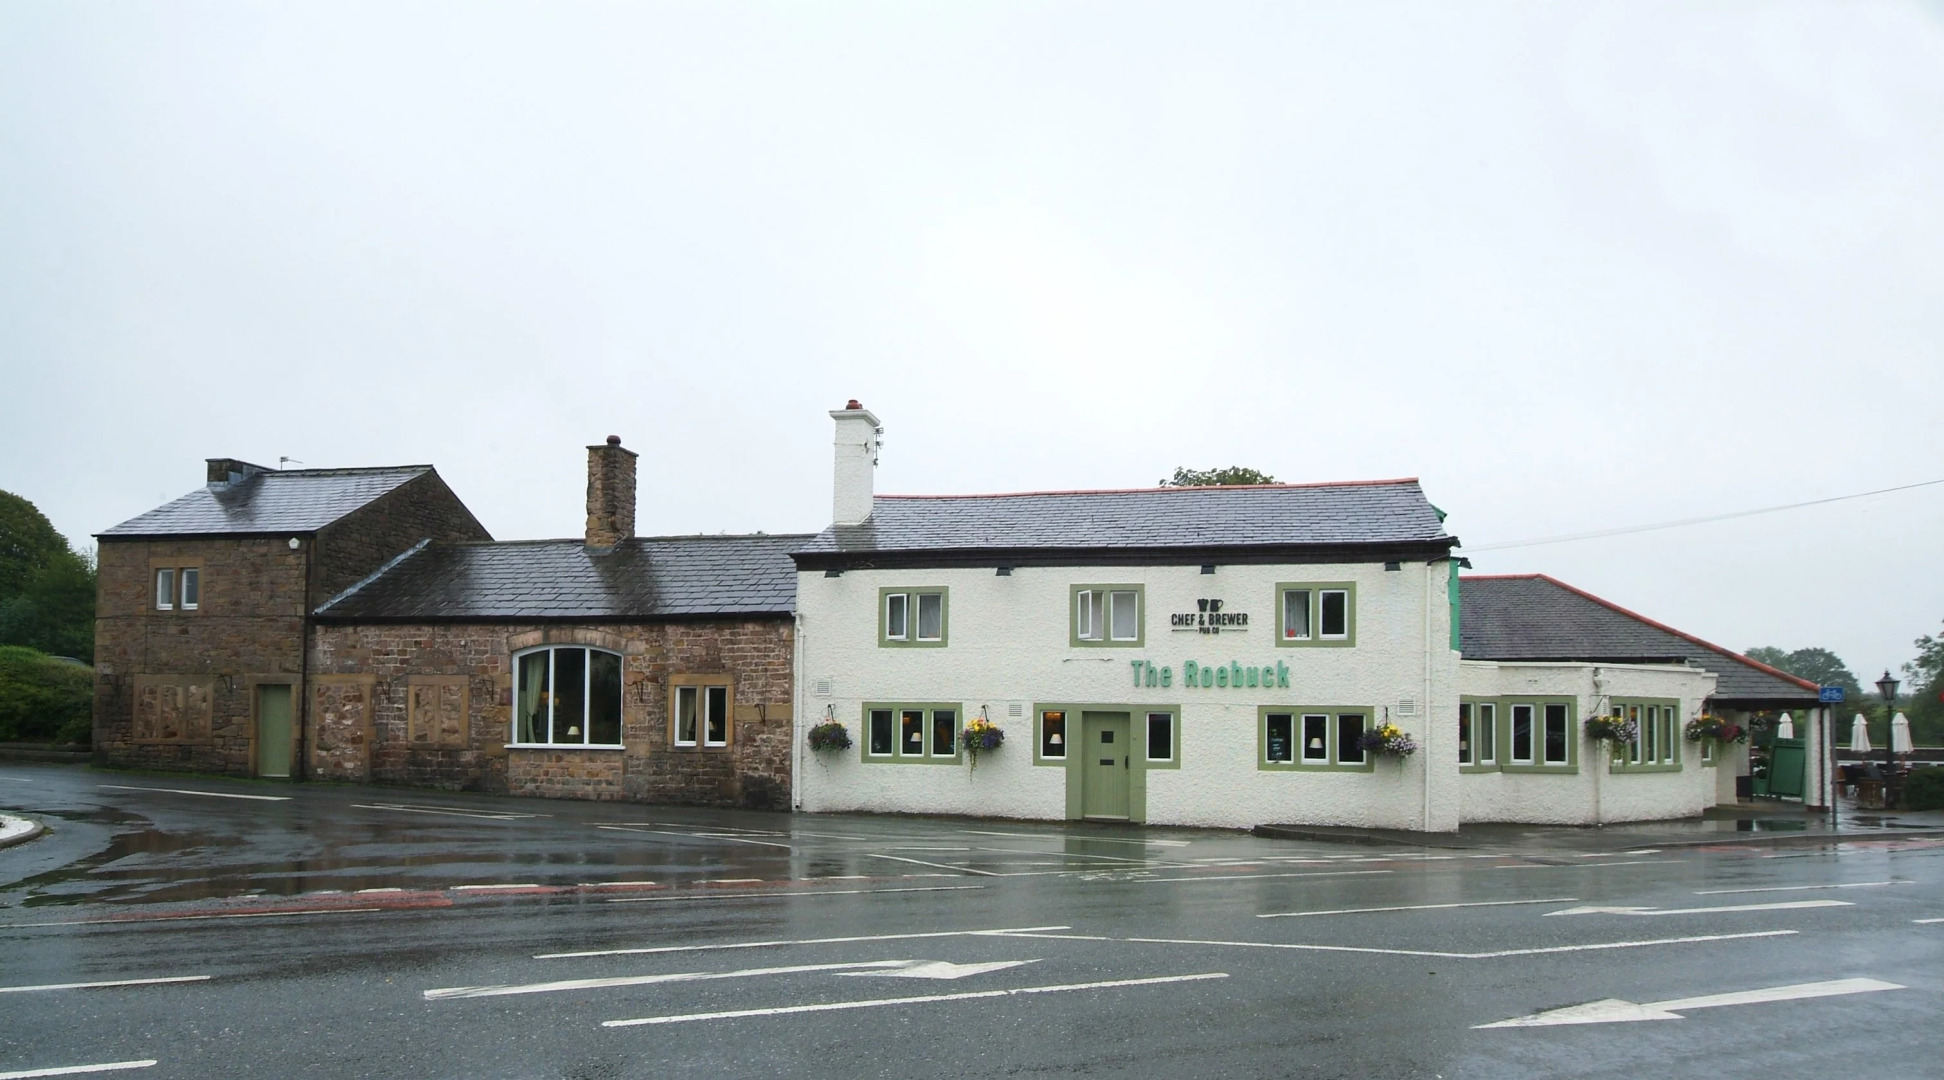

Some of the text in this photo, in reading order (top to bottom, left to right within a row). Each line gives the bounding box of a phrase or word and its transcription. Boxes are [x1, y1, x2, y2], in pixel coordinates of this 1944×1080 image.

[1171, 613, 1248, 626] CHEF & BREWER
[1130, 659, 1290, 688] The Roebuck
